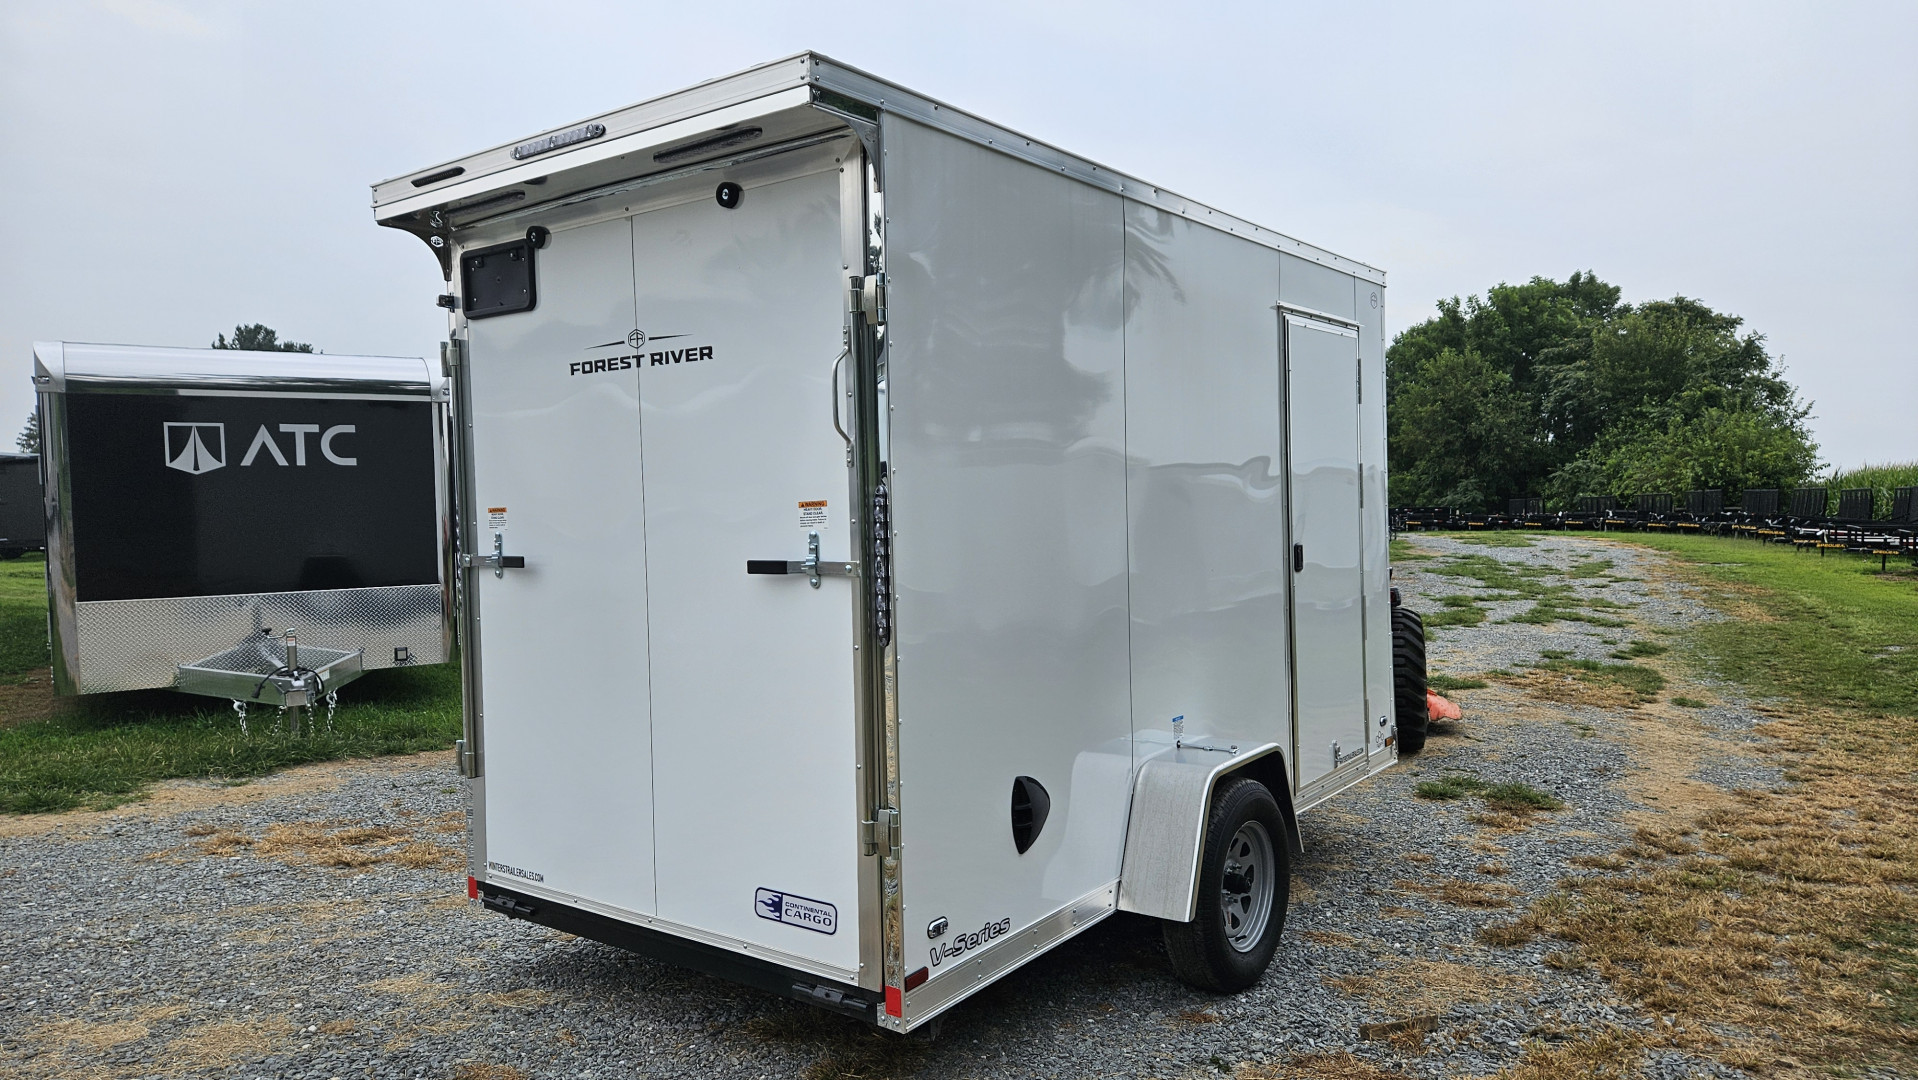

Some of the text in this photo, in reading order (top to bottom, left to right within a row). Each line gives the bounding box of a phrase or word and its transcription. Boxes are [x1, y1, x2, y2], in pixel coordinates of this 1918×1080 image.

[569, 346, 714, 376] FOREST RIVER
[240, 423, 357, 466] ATC
[784, 908, 832, 927] CARGO
[785, 901, 833, 918] CONTINENTAL
[930, 917, 1011, 967] V-Series
